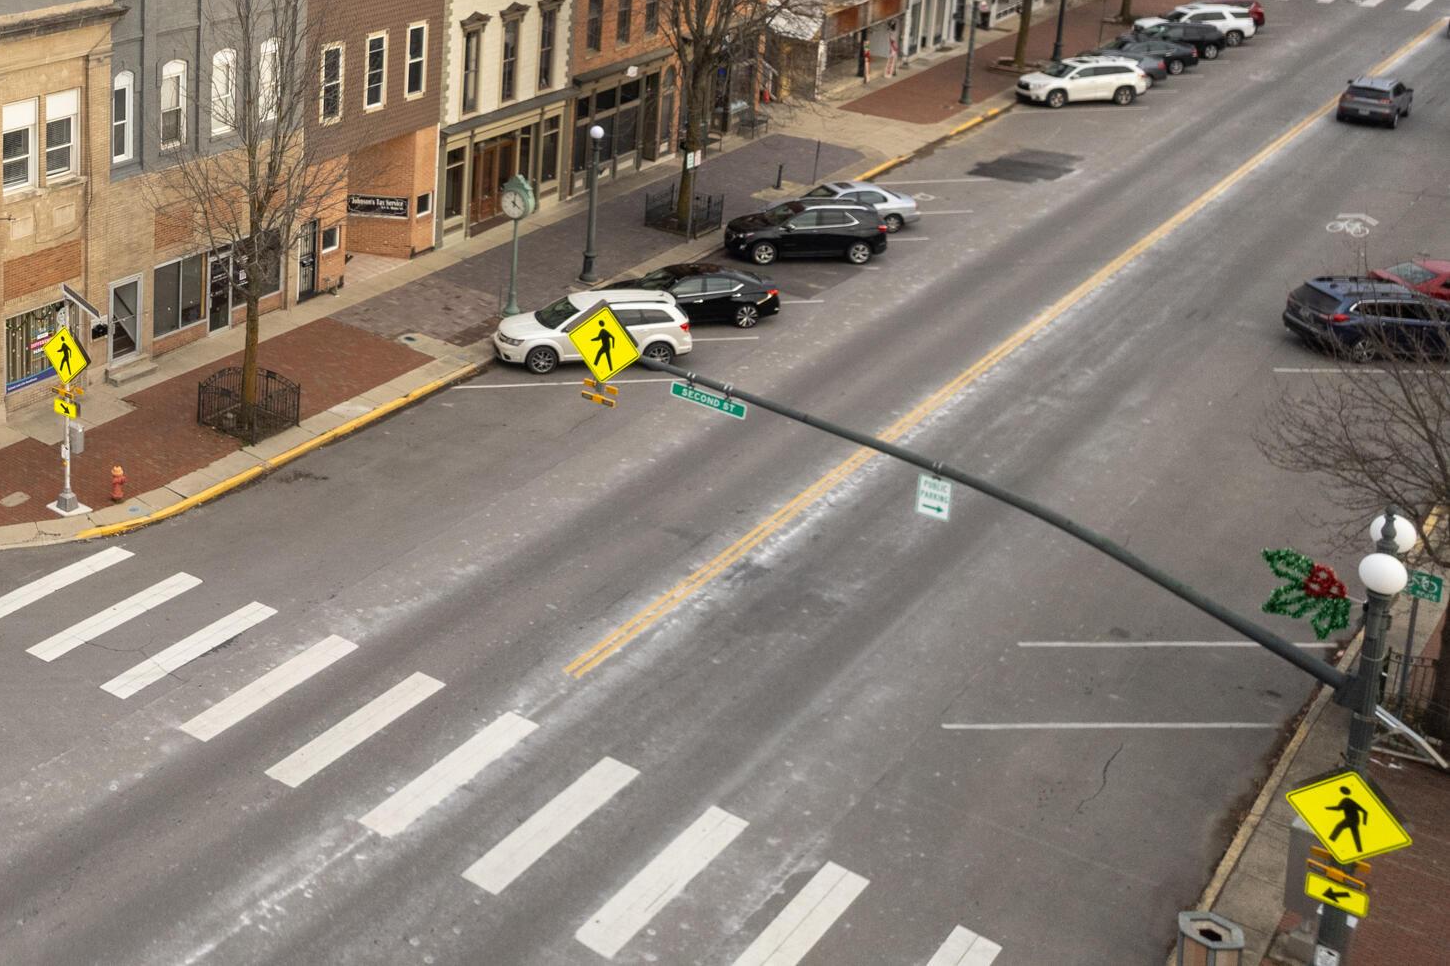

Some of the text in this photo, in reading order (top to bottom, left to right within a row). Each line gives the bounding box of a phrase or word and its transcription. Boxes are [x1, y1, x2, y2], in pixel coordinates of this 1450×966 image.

[351, 197, 376, 206] Johnson's
[386, 199, 404, 207] Service
[681, 387, 736, 412] SECOND ST
[924, 479, 949, 493] PUBLIC
[920, 489, 950, 504] PARKING
